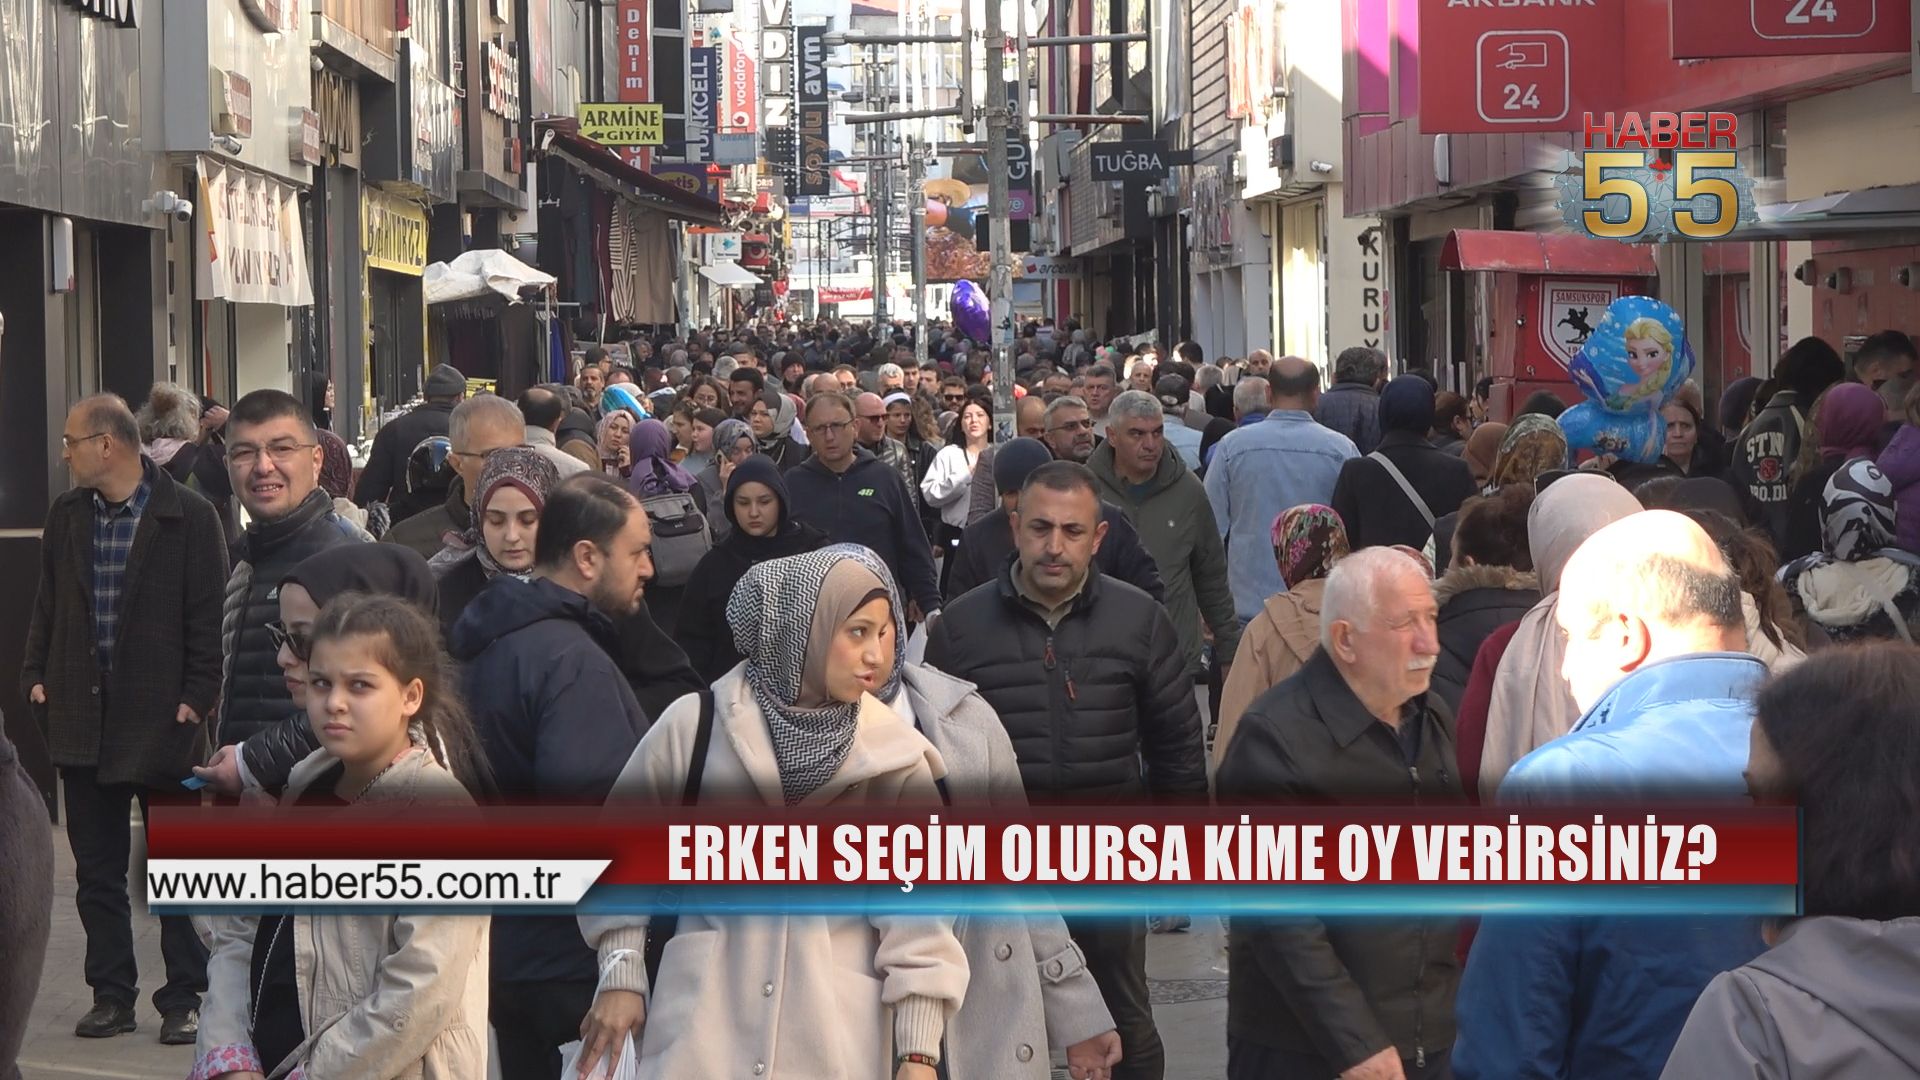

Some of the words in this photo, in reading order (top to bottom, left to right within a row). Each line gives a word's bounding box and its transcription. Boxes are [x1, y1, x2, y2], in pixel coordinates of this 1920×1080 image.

[1785, 0, 1838, 24] 24
[626, 9, 643, 89] Denim
[803, 36, 821, 96] avm
[1503, 83, 1540, 110] 24
[583, 106, 660, 127] ARMİNE
[606, 128, 657, 141] GİYİM
[800, 111, 828, 185] soylu
[1095, 150, 1163, 173] TUĞBA
[1556, 291, 1607, 303] SAMSUNSPOR
